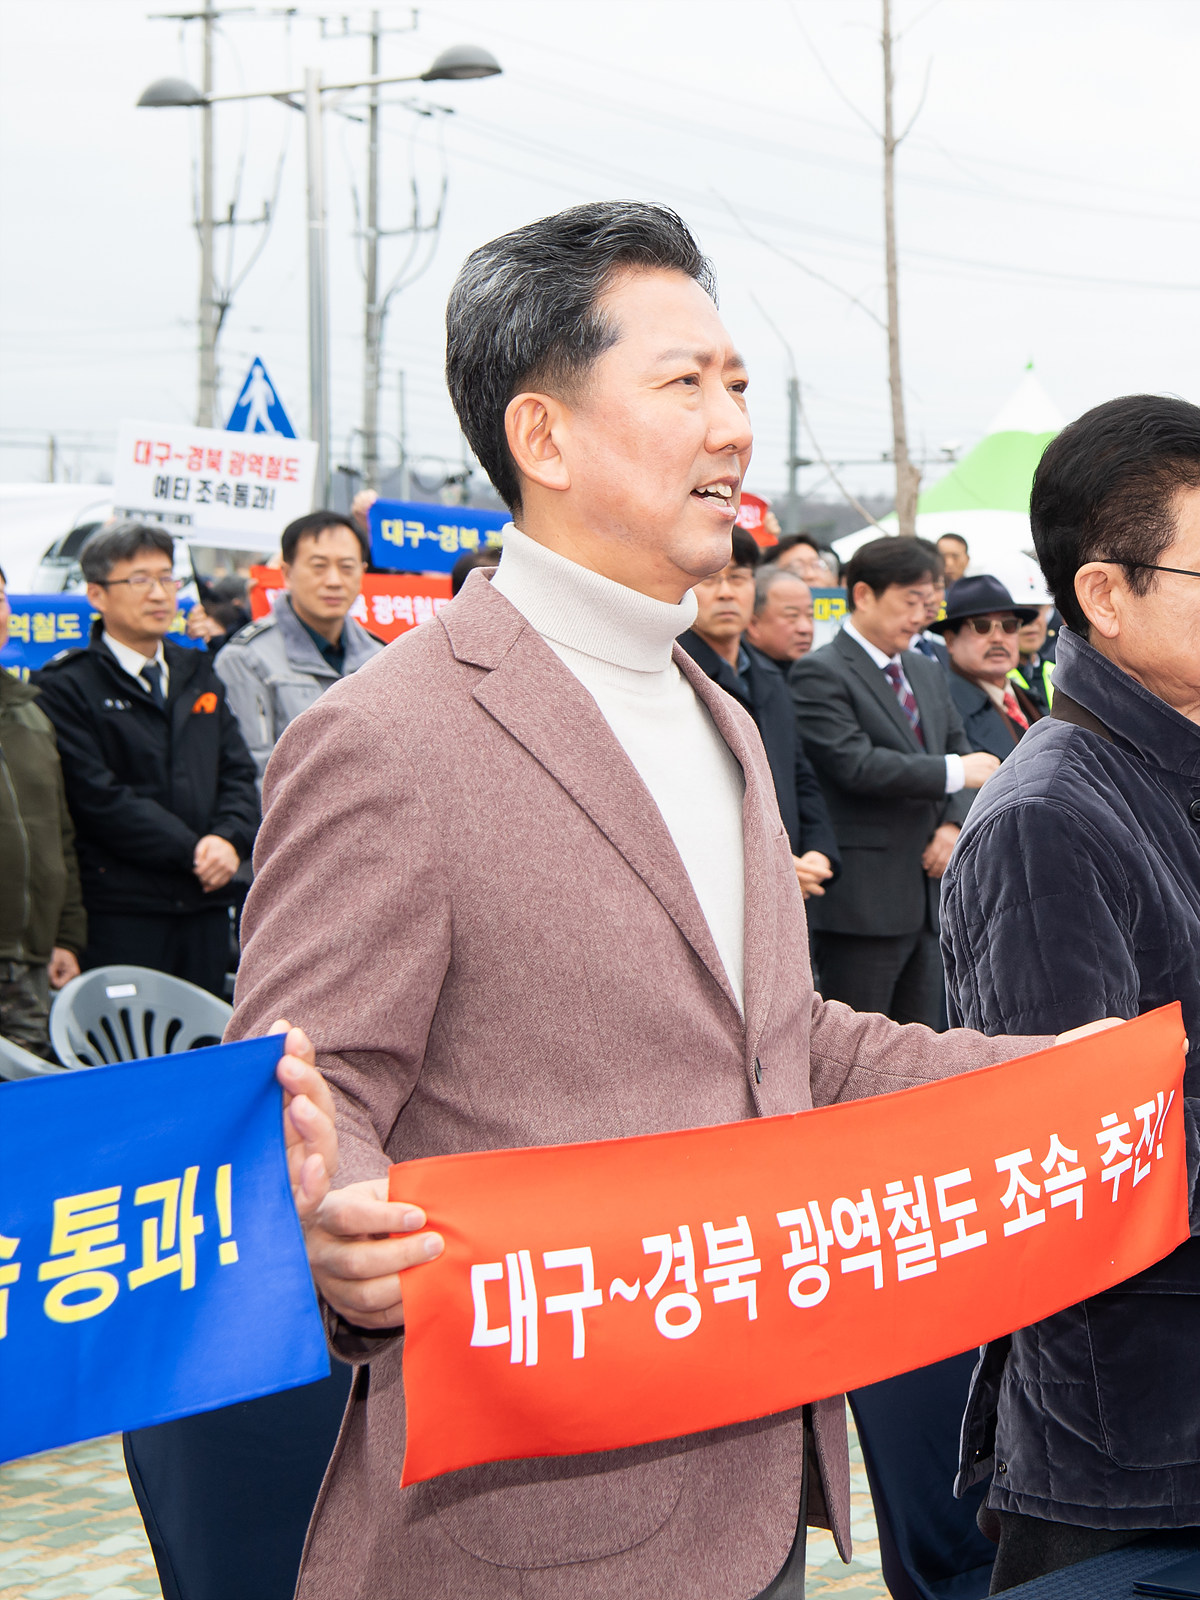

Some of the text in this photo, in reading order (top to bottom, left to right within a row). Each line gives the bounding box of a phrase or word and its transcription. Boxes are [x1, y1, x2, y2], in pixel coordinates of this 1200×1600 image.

[133, 439, 300, 482] 대구~경북 광역철도
[153, 474, 190, 501] 예타
[380, 518, 481, 553] 대구~경북
[7, 612, 82, 644] 역철도
[470, 1089, 1175, 1367] 대구~경북 광역철도 조속 추진!
[0, 1164, 238, 1340] 통과!
